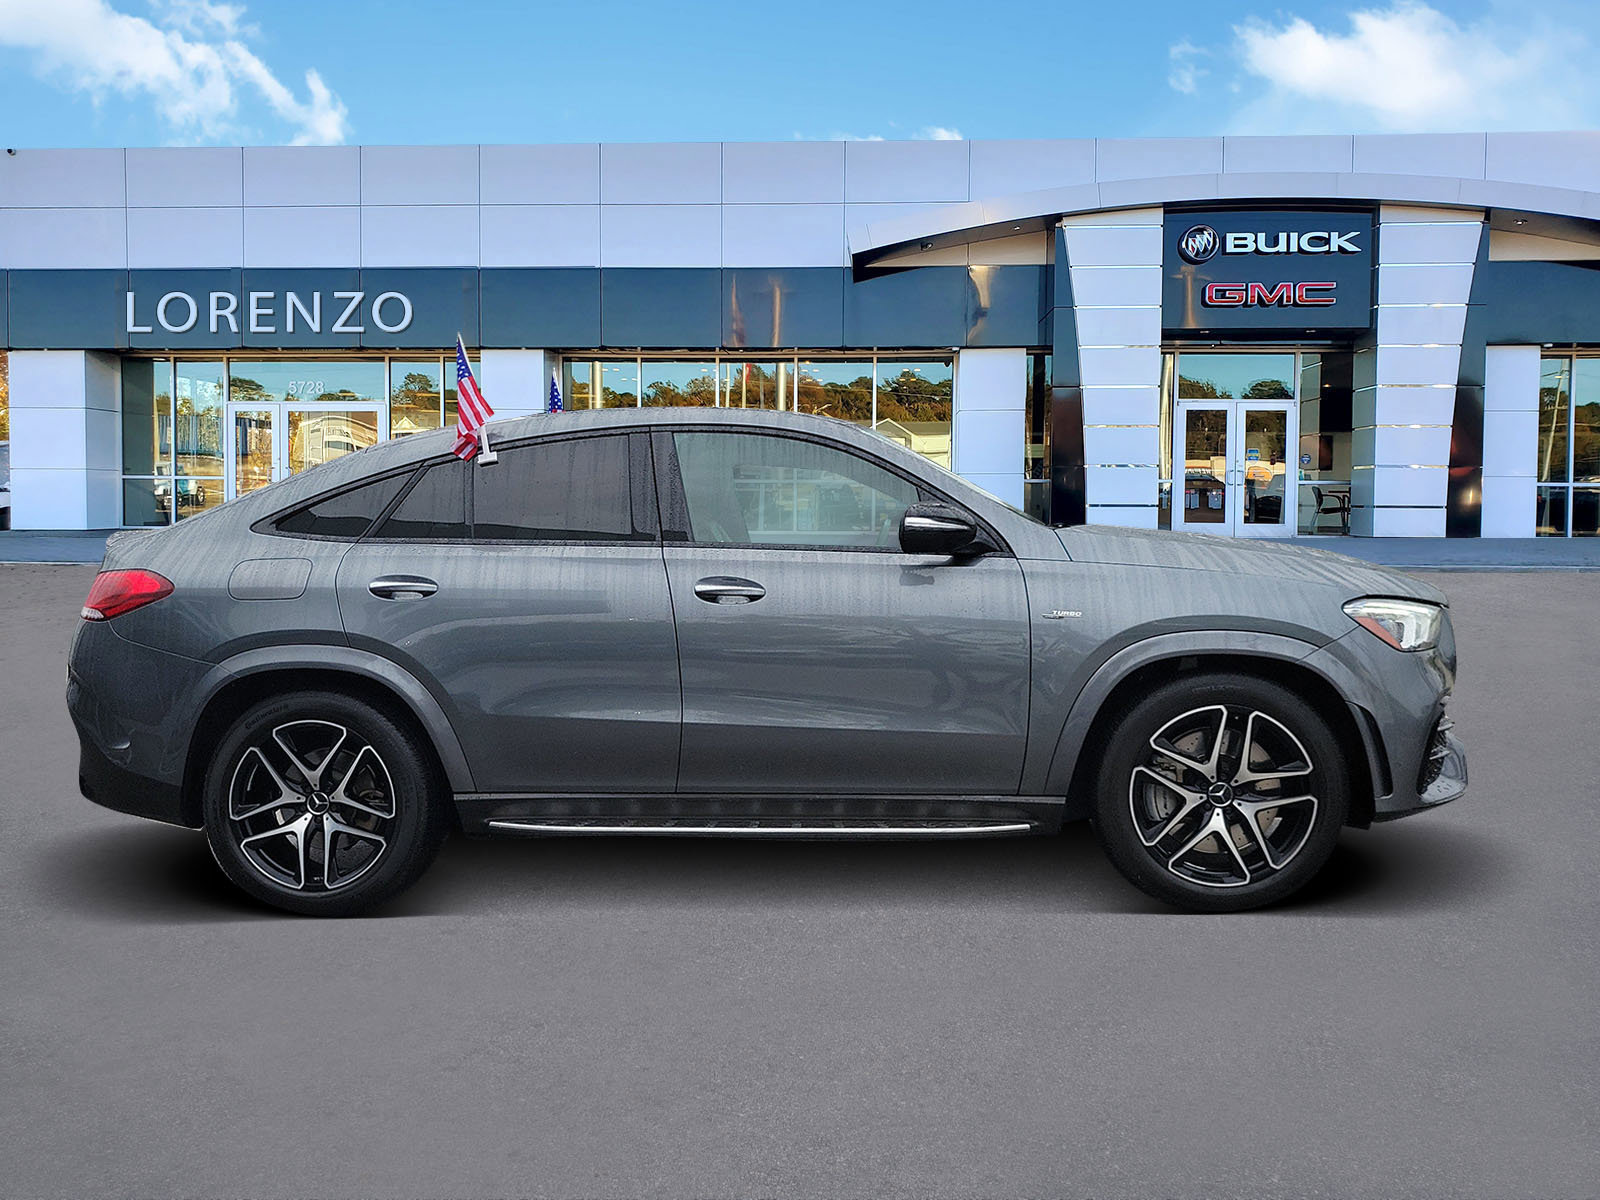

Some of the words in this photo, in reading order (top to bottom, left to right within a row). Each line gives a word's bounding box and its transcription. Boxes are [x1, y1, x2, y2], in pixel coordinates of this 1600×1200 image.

[1224, 230, 1362, 254] BUICK
[1203, 281, 1337, 306] GMC
[126, 290, 414, 334] LORENZO
[288, 380, 325, 395] 5728
[1052, 609, 1082, 617] TURBO
